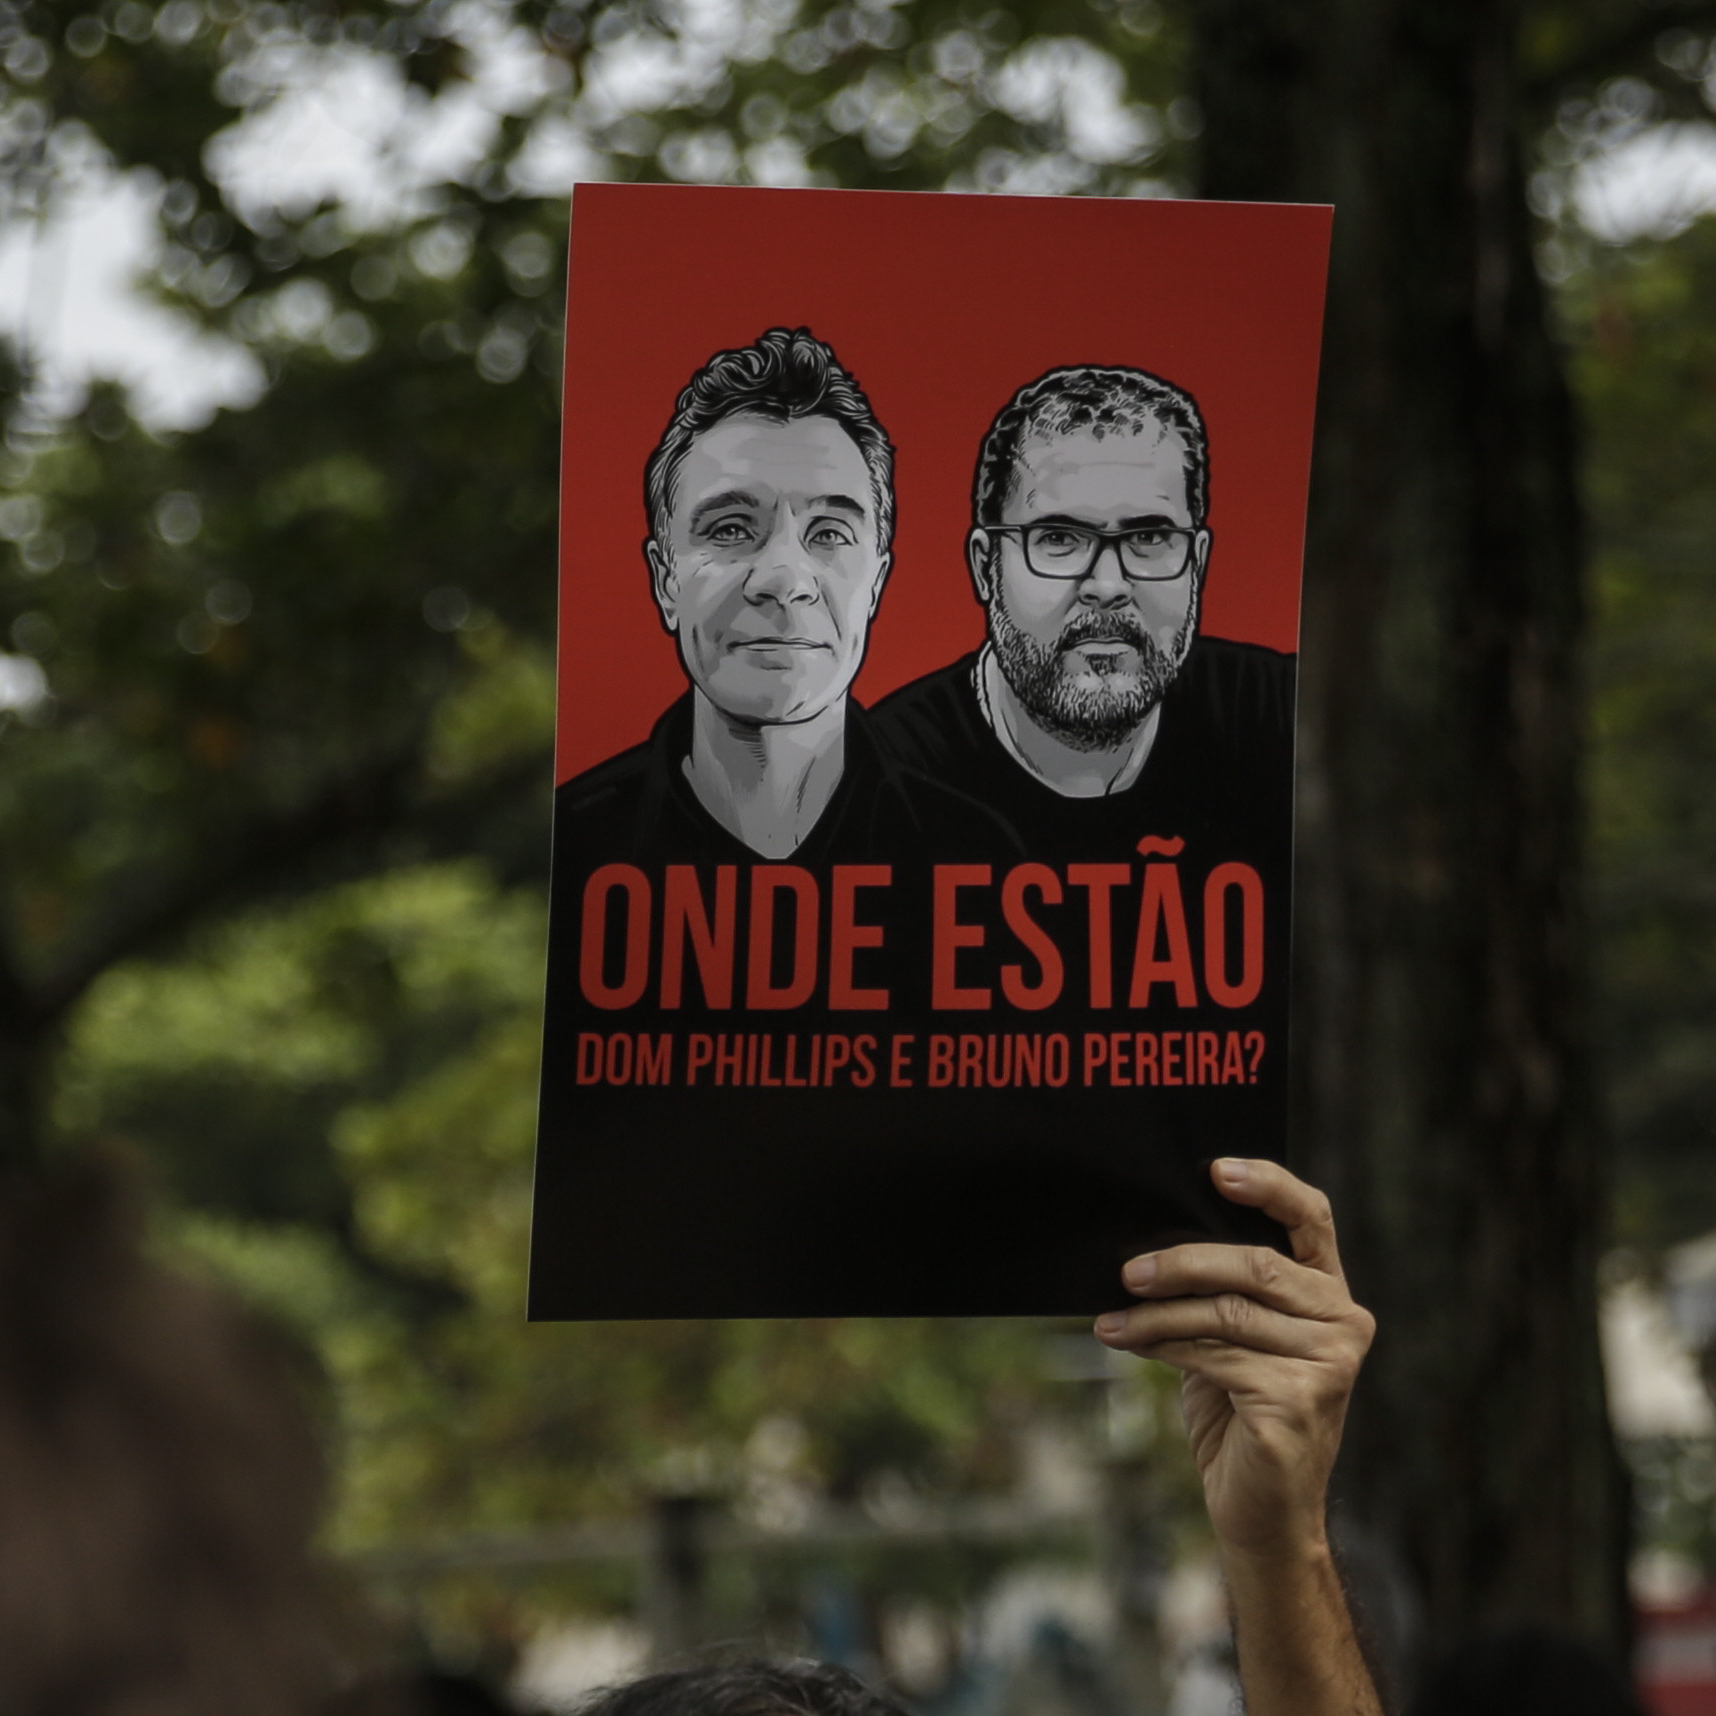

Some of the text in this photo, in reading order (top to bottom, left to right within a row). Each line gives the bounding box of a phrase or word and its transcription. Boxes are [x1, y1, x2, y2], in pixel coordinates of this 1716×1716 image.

[579, 834, 1265, 1011] ONDE ESTÃO
[576, 1031, 1266, 1087] DOM PHILLIPS E BRUNO PEREIRA?
